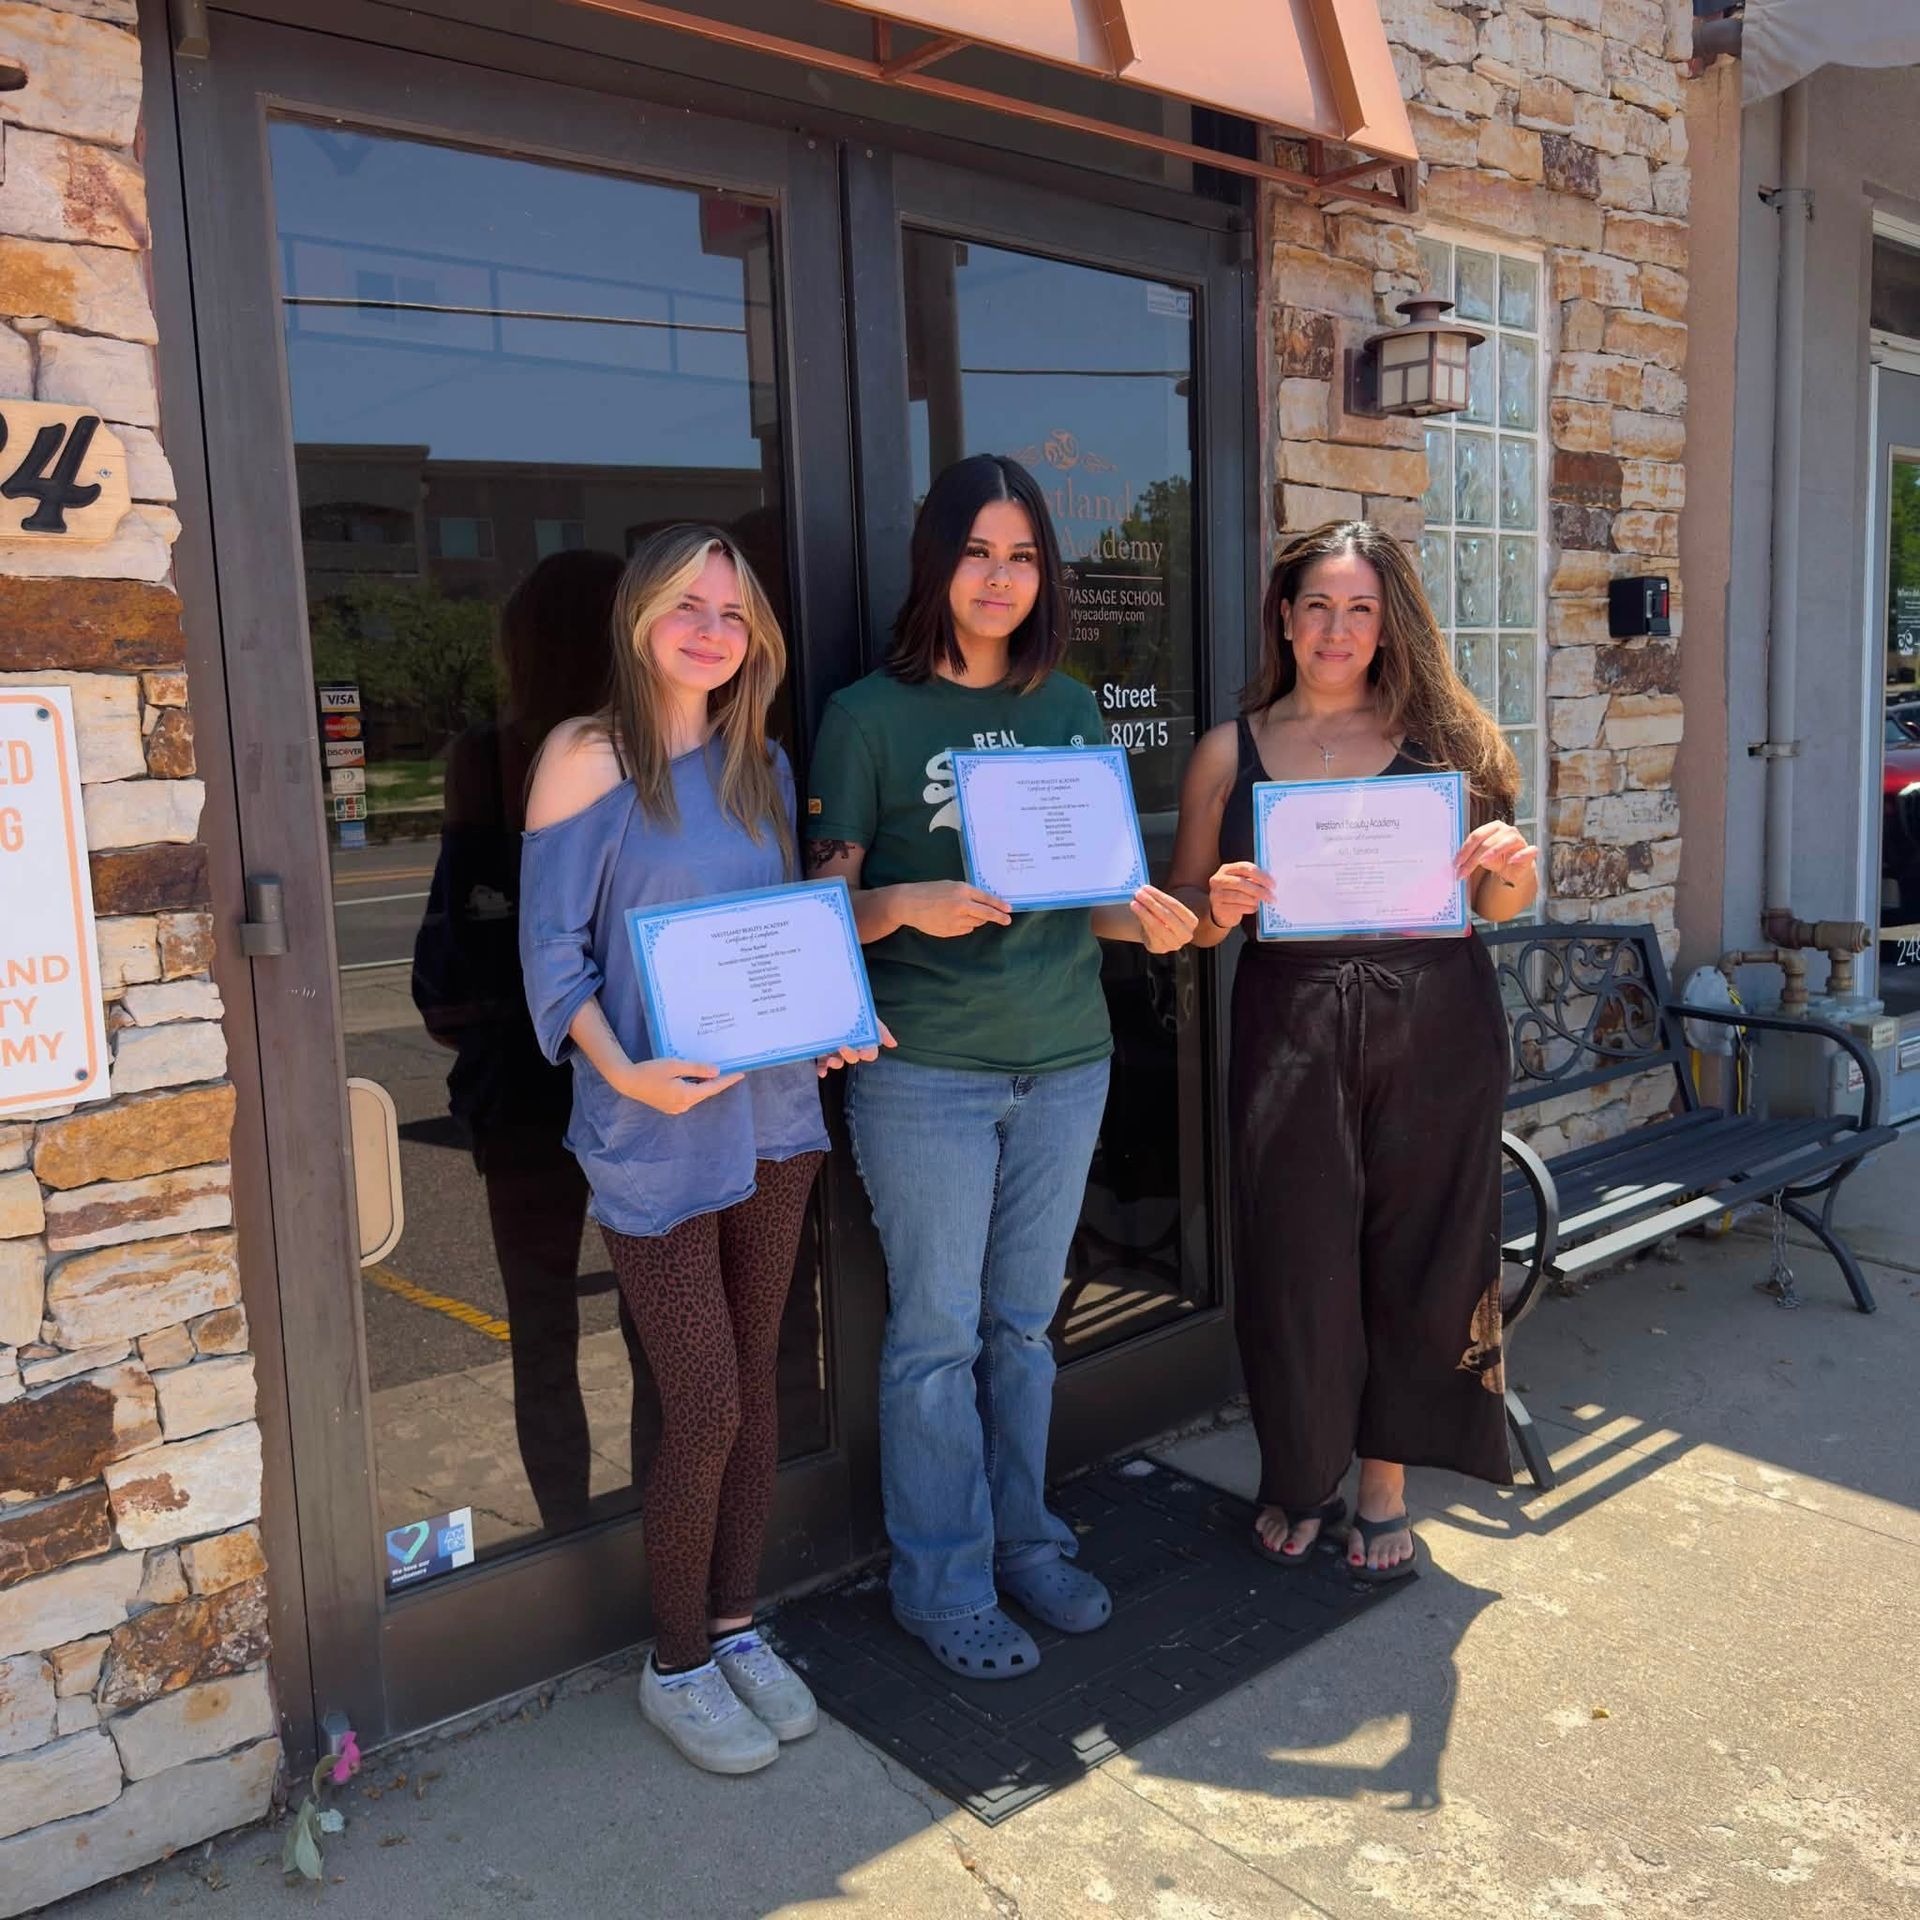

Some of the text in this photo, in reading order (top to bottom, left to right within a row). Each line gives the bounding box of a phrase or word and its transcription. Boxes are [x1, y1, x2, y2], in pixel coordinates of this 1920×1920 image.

[0, 411, 101, 534] 4
[1060, 526, 1163, 568] Academy
[1120, 591, 1165, 606] SCHOOL
[1070, 627, 1099, 642] .2039
[327, 695, 354, 705] VISA
[1103, 682, 1157, 708] Street
[973, 730, 1024, 750] REAL
[1111, 722, 1168, 748] 80215
[327, 748, 362, 756] DISCOVER
[0, 955, 69, 988] ND
[2, 1031, 64, 1067] MY
